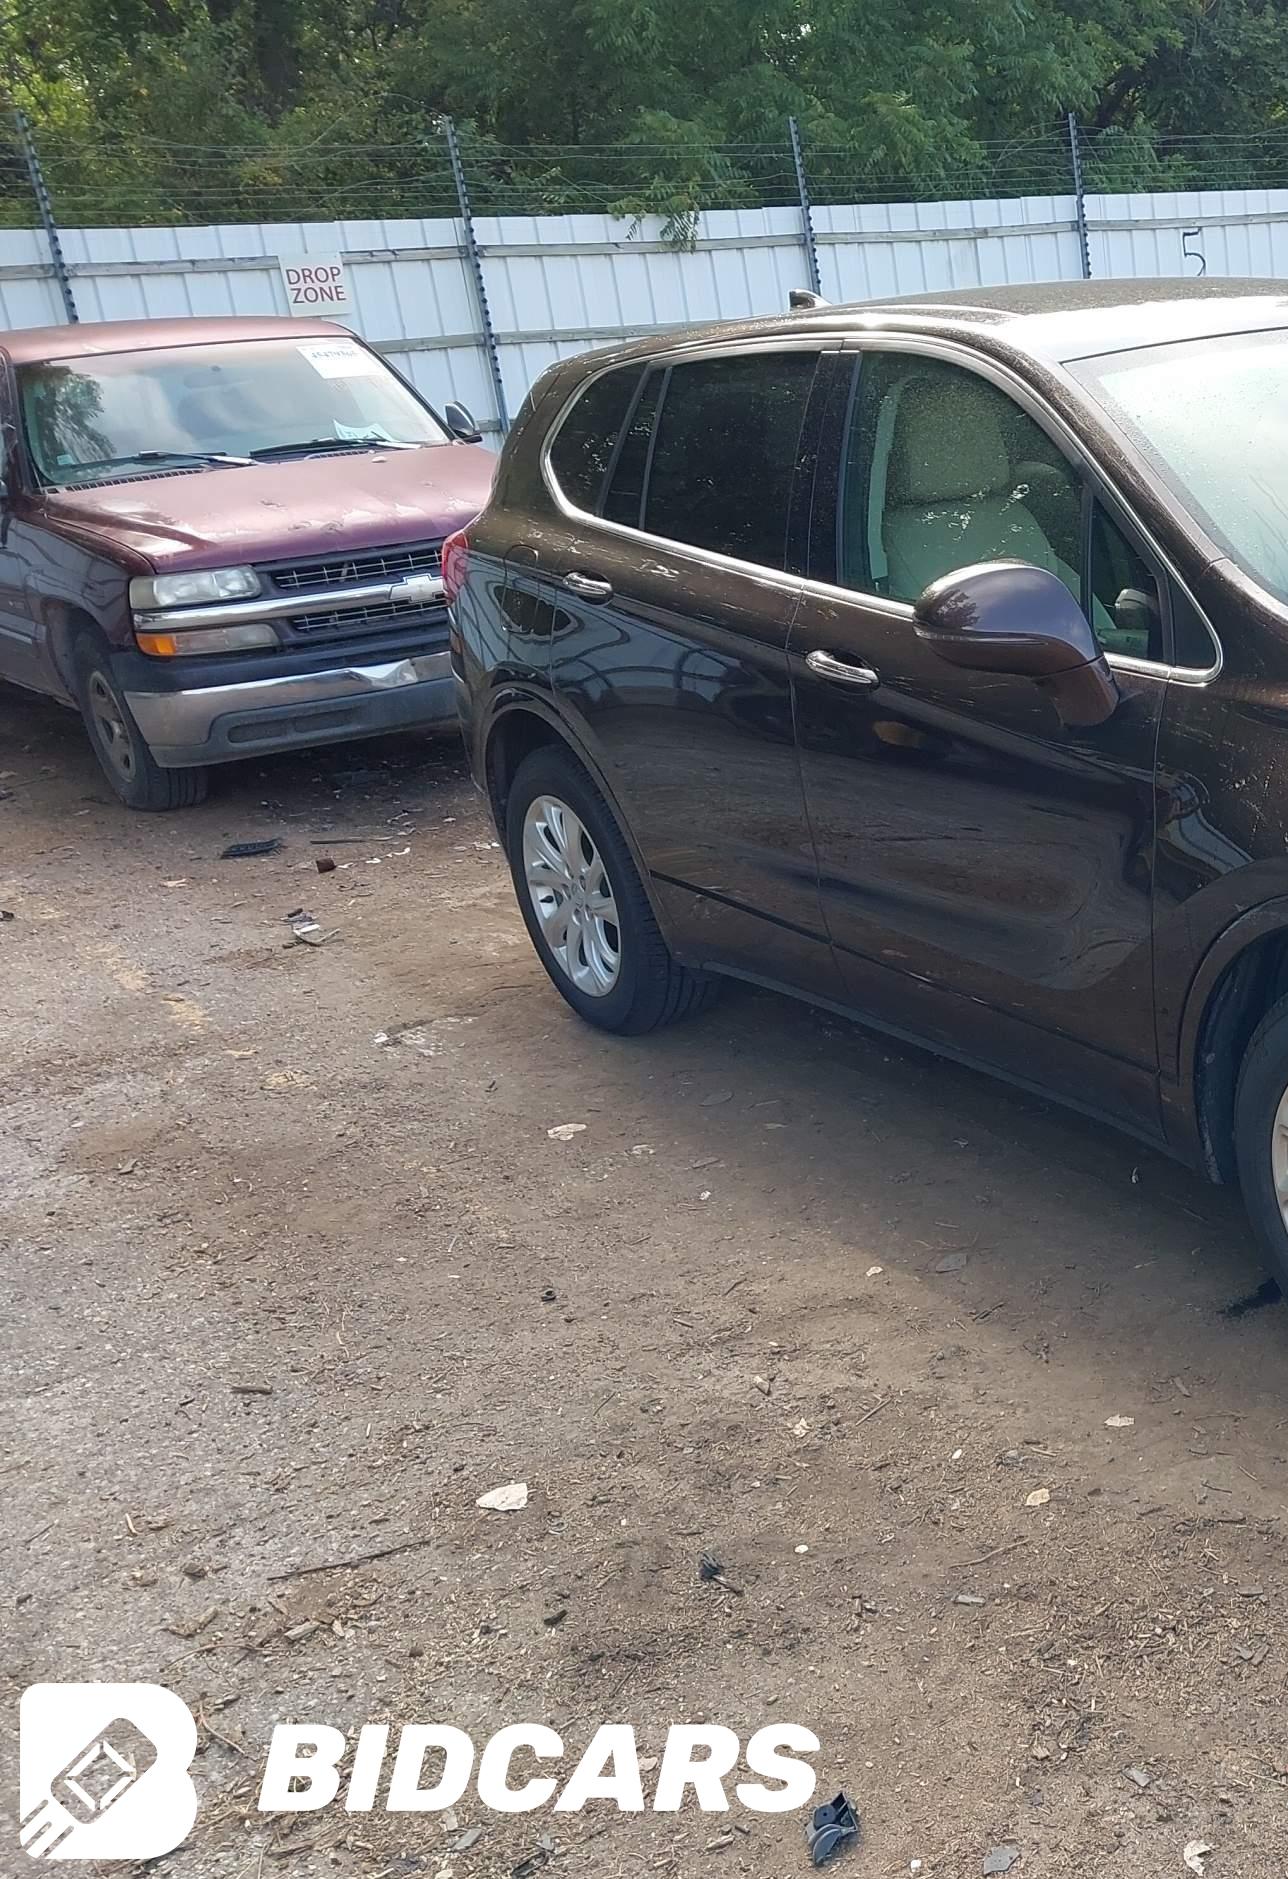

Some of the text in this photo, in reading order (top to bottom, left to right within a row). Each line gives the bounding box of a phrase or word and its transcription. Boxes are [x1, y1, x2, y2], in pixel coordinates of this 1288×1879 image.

[1182, 227, 1206, 277] 5
[285, 266, 341, 285] DROP
[290, 285, 346, 304] ZONE
